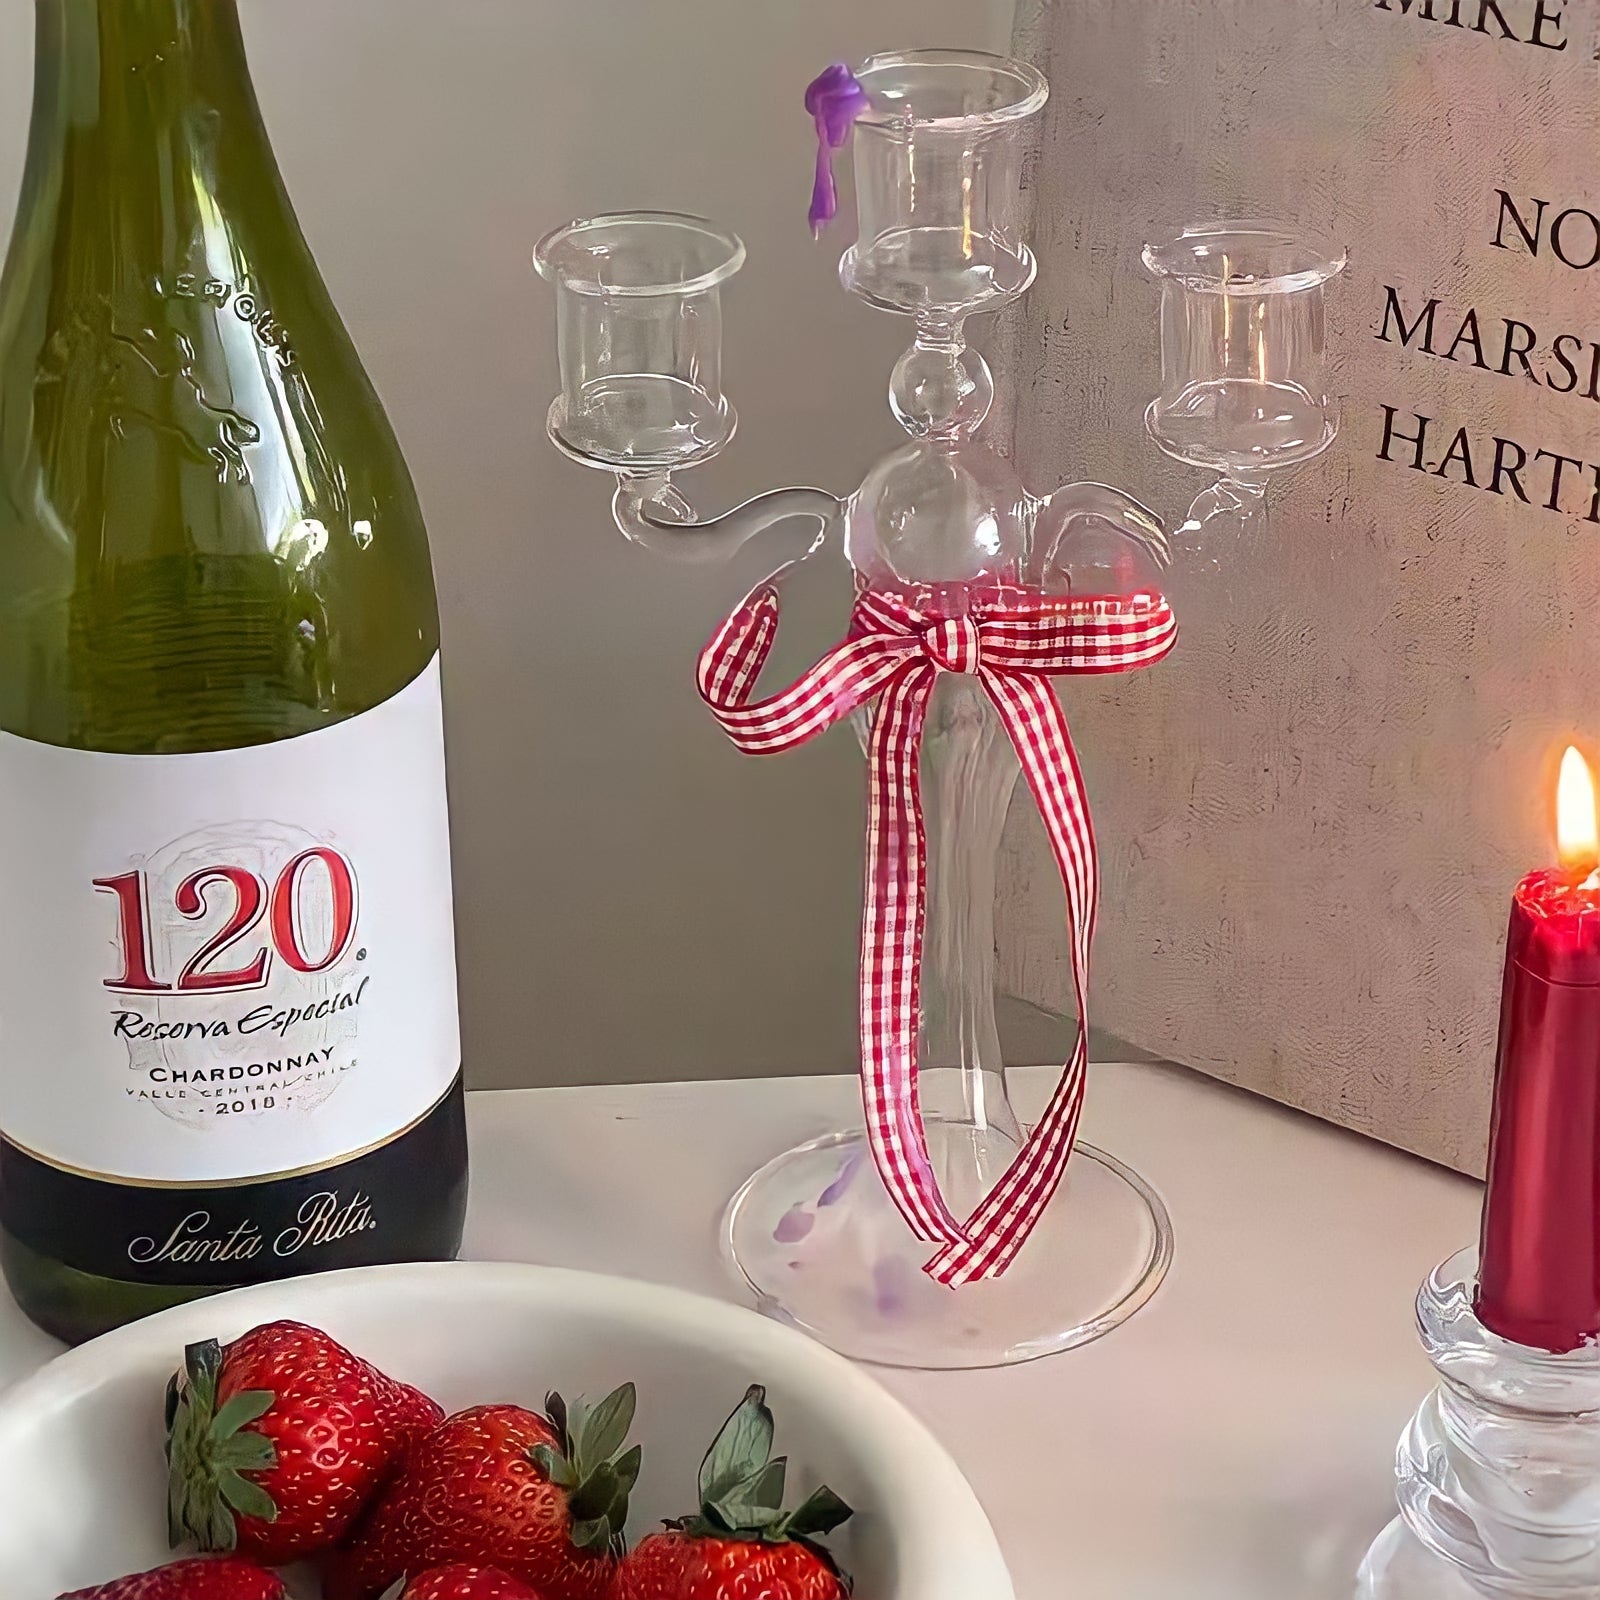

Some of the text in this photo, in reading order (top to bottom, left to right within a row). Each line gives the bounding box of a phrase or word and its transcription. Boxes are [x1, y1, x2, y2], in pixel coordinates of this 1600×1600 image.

[1375, 0, 1568, 51] IKE
[149, 1046, 335, 1084] CHARDONNAY
[127, 1210, 264, 1264] Santa
